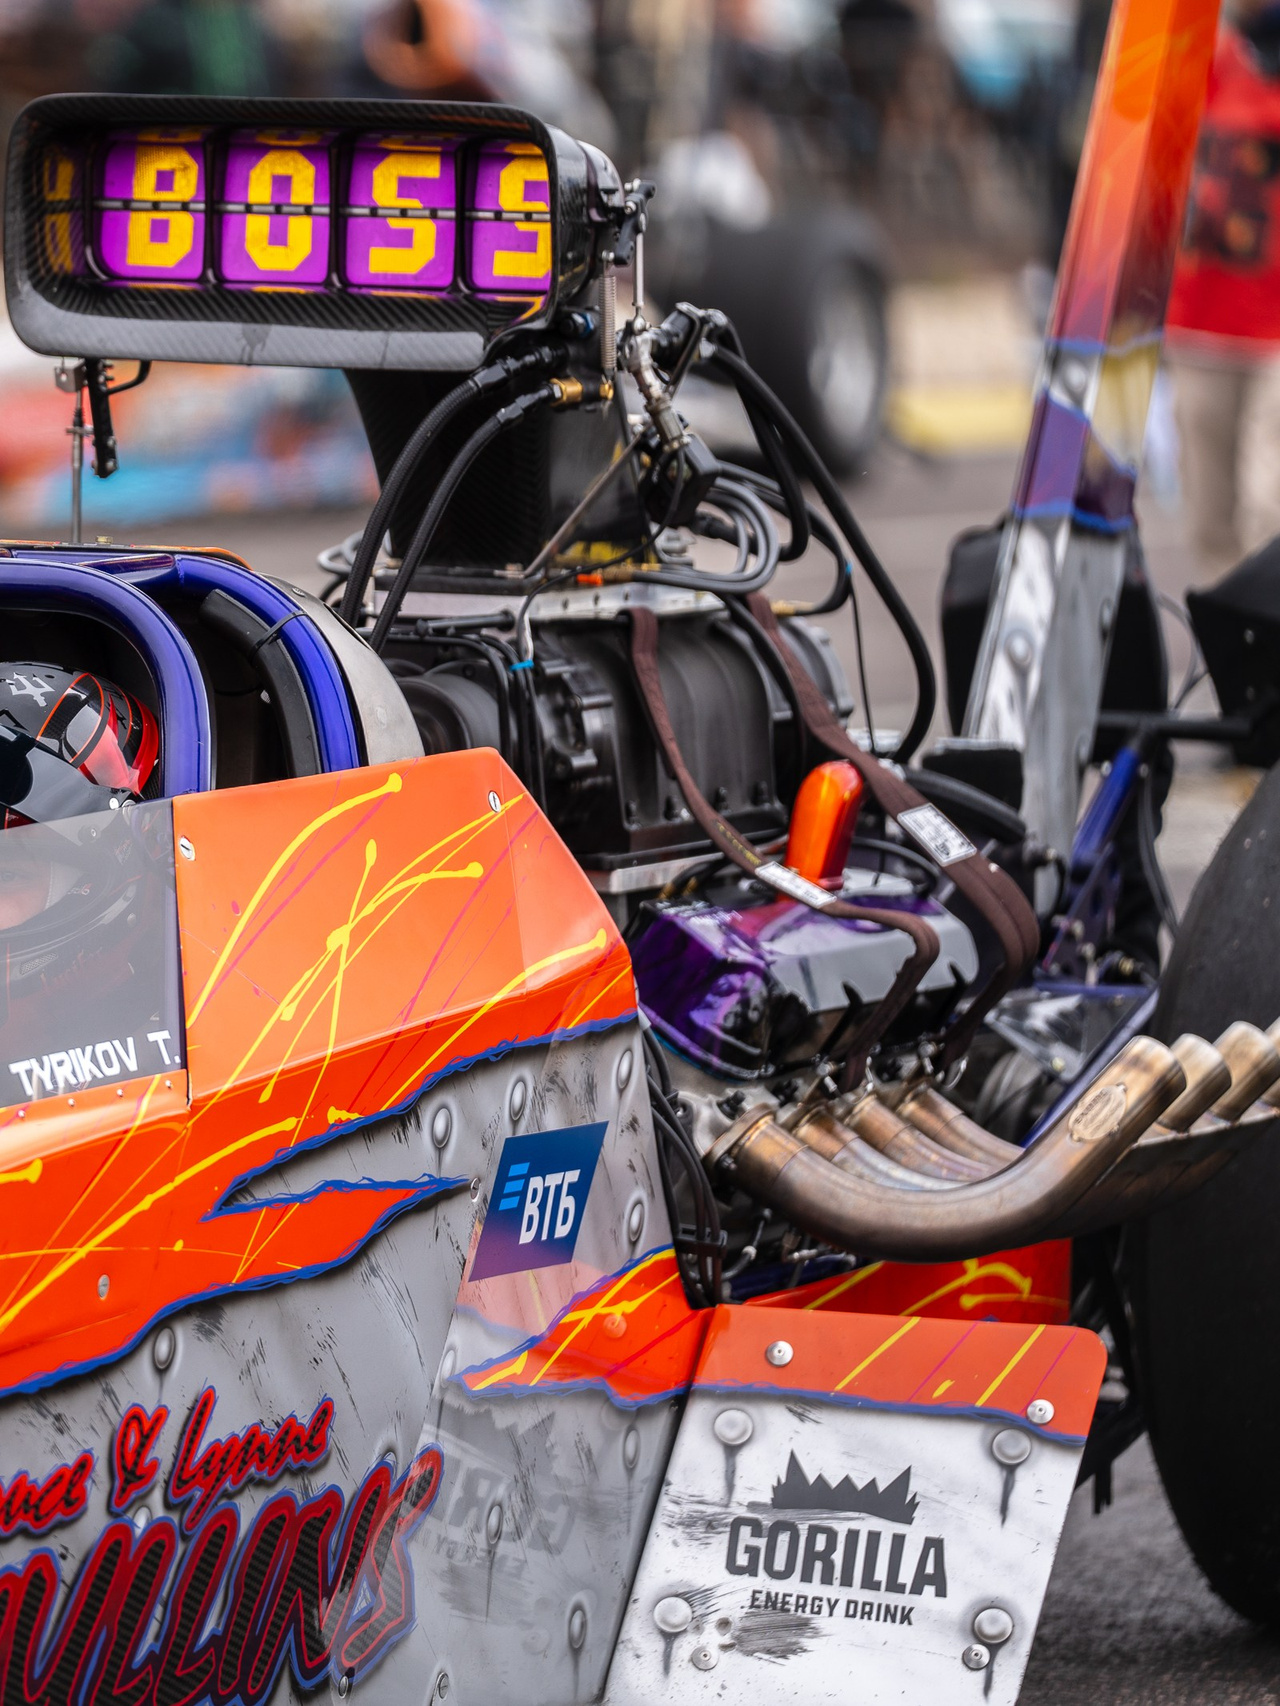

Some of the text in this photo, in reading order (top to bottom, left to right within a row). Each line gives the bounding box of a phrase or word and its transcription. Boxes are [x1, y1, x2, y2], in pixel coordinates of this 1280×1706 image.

[126, 145, 551, 279] BOSS
[8, 1029, 181, 1096] TYRIKOV T.
[519, 1169, 581, 1245] ВТБ
[170, 1385, 334, 1534] Lynne
[725, 1515, 948, 1598] GORILLA
[748, 1589, 916, 1626] ENERGY DRINK
